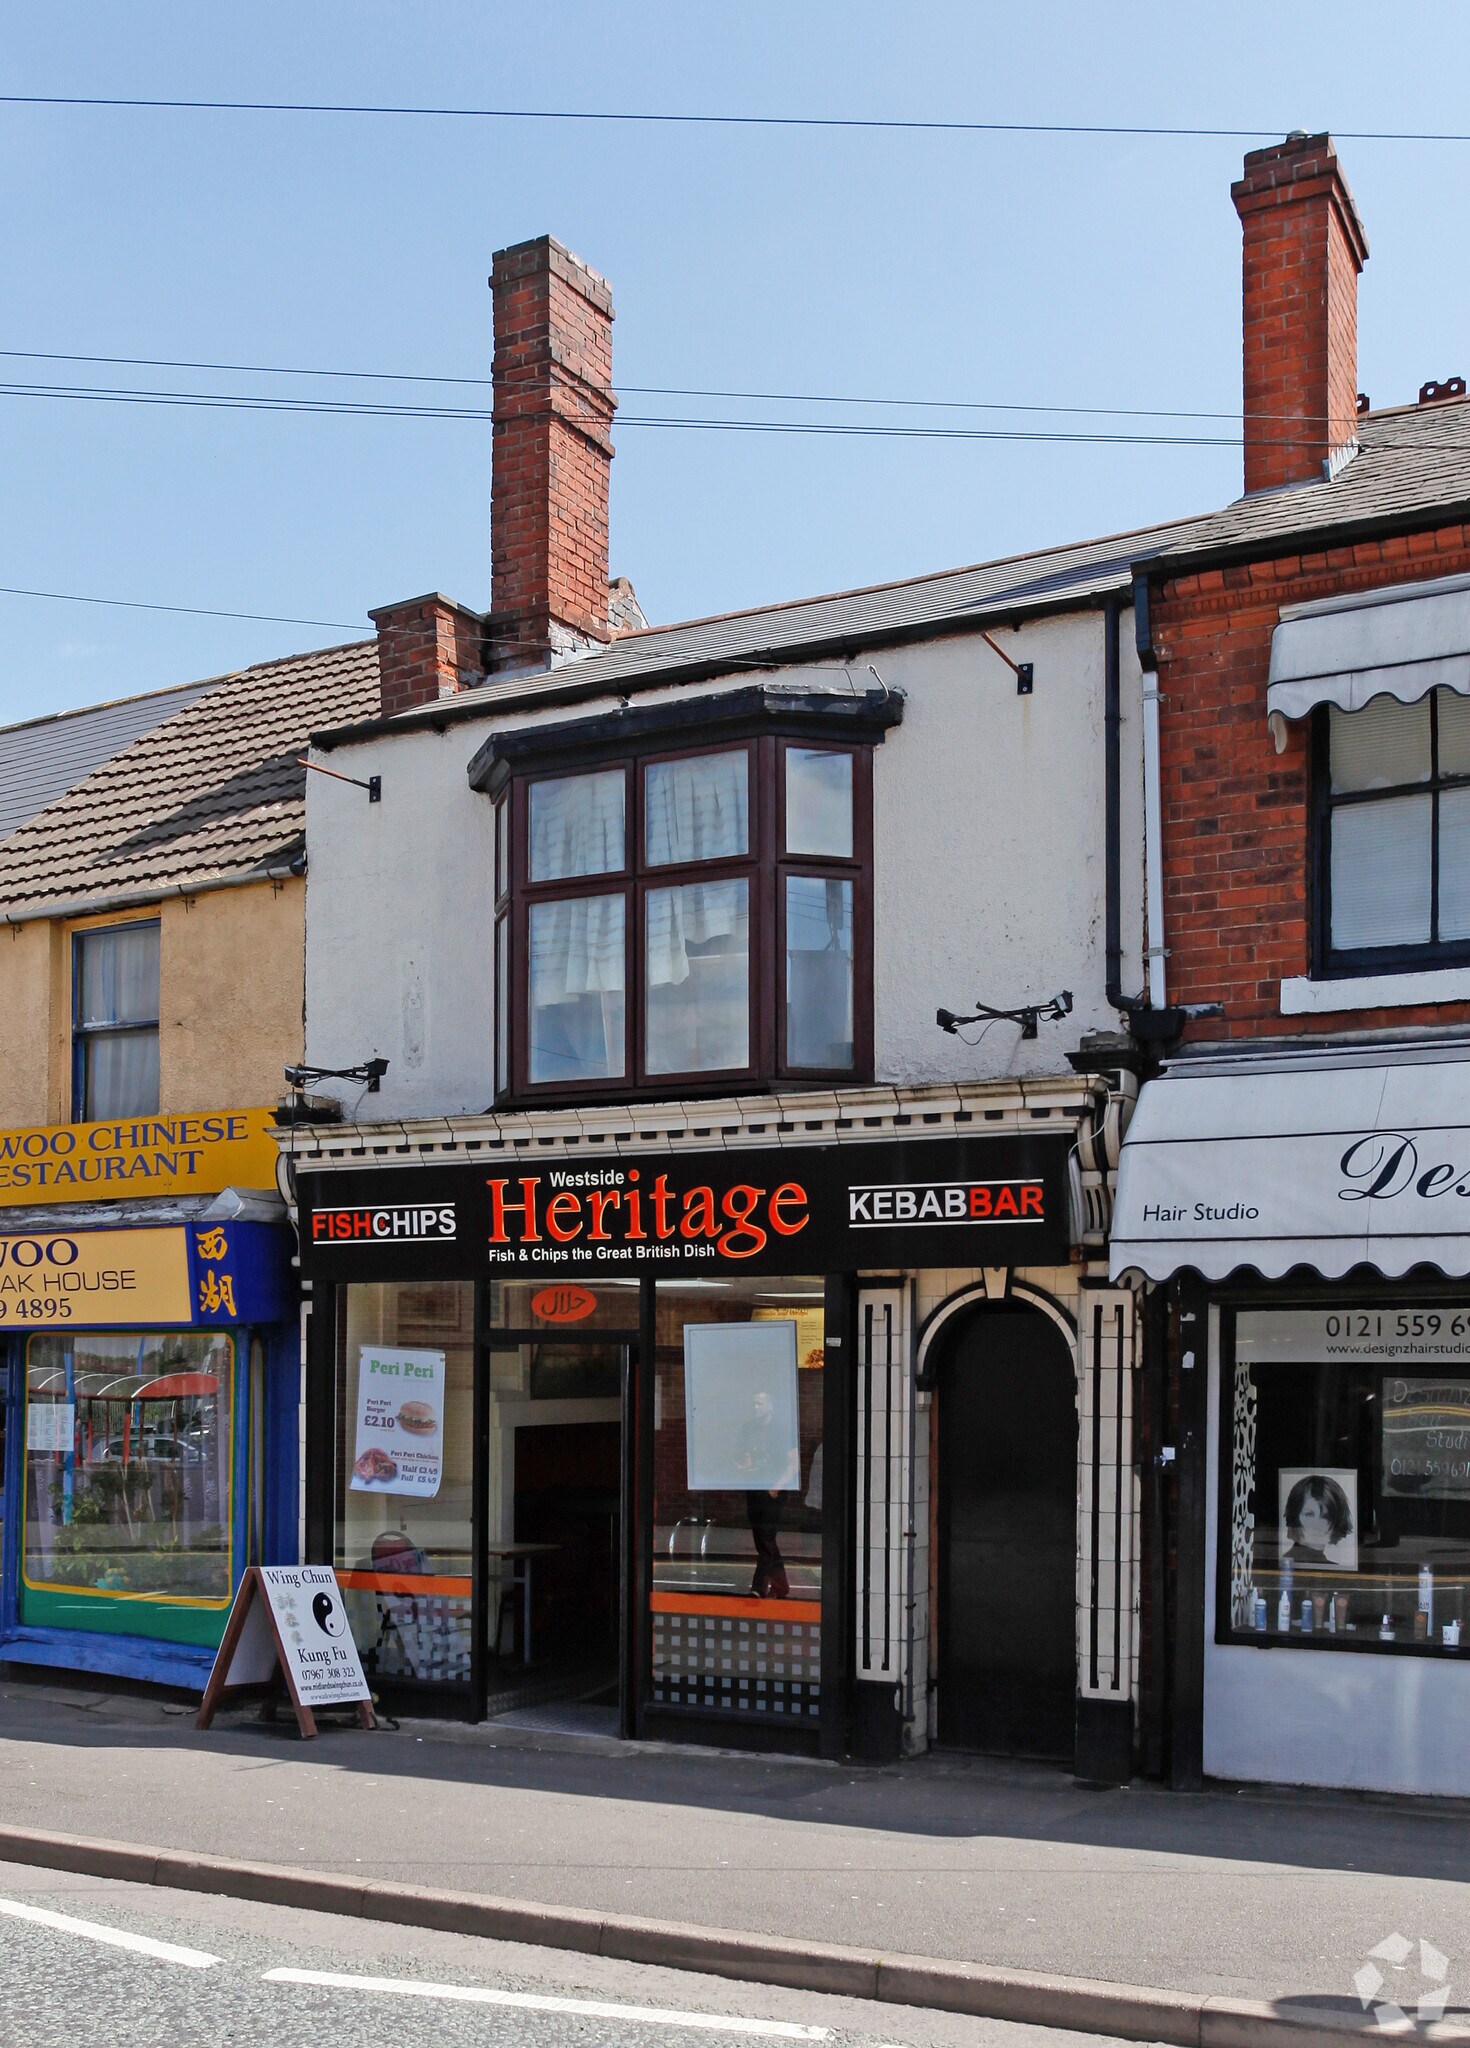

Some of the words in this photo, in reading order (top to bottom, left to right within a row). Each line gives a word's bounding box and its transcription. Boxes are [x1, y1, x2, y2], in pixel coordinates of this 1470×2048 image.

[88, 1116, 249, 1151] CHINESE
[550, 1169, 625, 1188] Westside
[486, 1168, 810, 1259] Heritage
[1142, 1203, 1187, 1222] Hair
[1194, 1202, 1260, 1222] Studio
[488, 1249, 515, 1262] Fish
[519, 1249, 528, 1261] &
[531, 1248, 568, 1264] Chips
[572, 1247, 593, 1260] the
[596, 1246, 632, 1260] Great
[636, 1244, 680, 1258] British
[684, 1243, 715, 1257] Dish
[43, 1269, 136, 1292] HOUSE
[16, 1298, 72, 1318] 4895
[1326, 1315, 1381, 1337] 0121
[1395, 1315, 1441, 1336] 559
[1450, 1315, 1470, 1336] 6
[370, 1359, 400, 1375] Peri
[403, 1362, 434, 1378] Peri
[364, 1414, 395, 1429] £2.10
[400, 1474, 414, 1482] Full
[402, 1465, 417, 1473] Half
[266, 1570, 301, 1588] Wing
[301, 1569, 332, 1584] Chun
[297, 1648, 332, 1665] Kung
[332, 1646, 348, 1660] Fu
[302, 1668, 324, 1681] 07967
[327, 1668, 341, 1679] 308
[342, 1667, 356, 1678] 323
